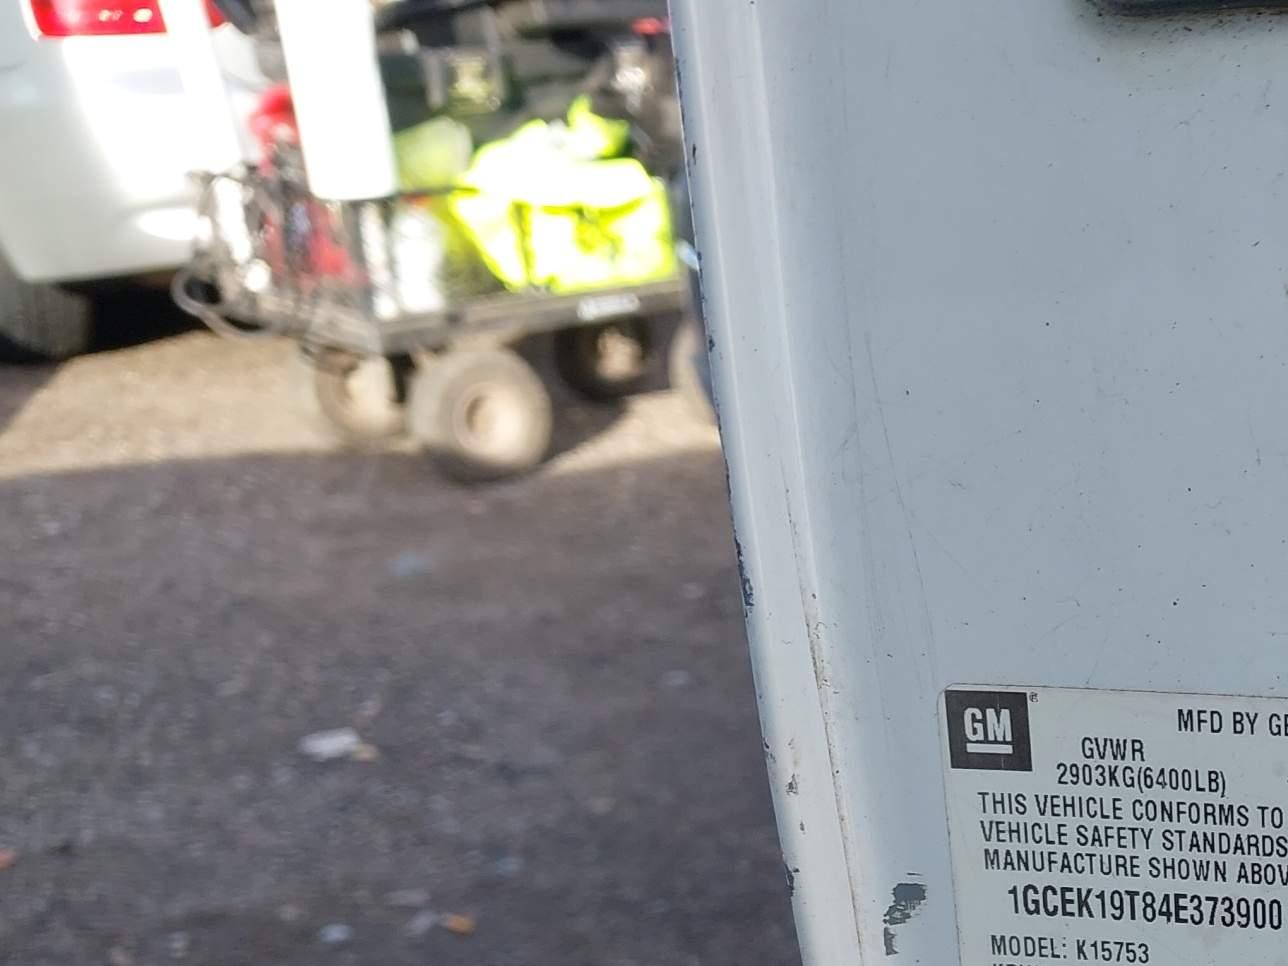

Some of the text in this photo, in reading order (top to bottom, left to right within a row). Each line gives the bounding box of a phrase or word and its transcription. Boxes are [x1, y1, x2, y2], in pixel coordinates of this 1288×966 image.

[964, 707, 1012, 742] GM
[1177, 708, 1223, 734] MFD
[1232, 711, 1259, 736] BY
[1081, 736, 1146, 763] GVWR
[1056, 762, 1226, 799] 2903KG(6400LB)
[976, 791, 1028, 816] THIS
[1034, 793, 1124, 821] VEHICLE
[1131, 798, 1250, 828] CONFORMS
[1256, 805, 1284, 830] TO
[979, 819, 1069, 846] VEHICLE
[1075, 824, 1154, 851] SAFETY
[1161, 828, 1288, 858] STANDARDS
[983, 847, 1141, 878] MANUFACTURE
[1148, 858, 1227, 883] SHOWN
[1007, 883, 1283, 931] 1GCEK19T84E373900
[990, 934, 1150, 965] MODEL: K15753
